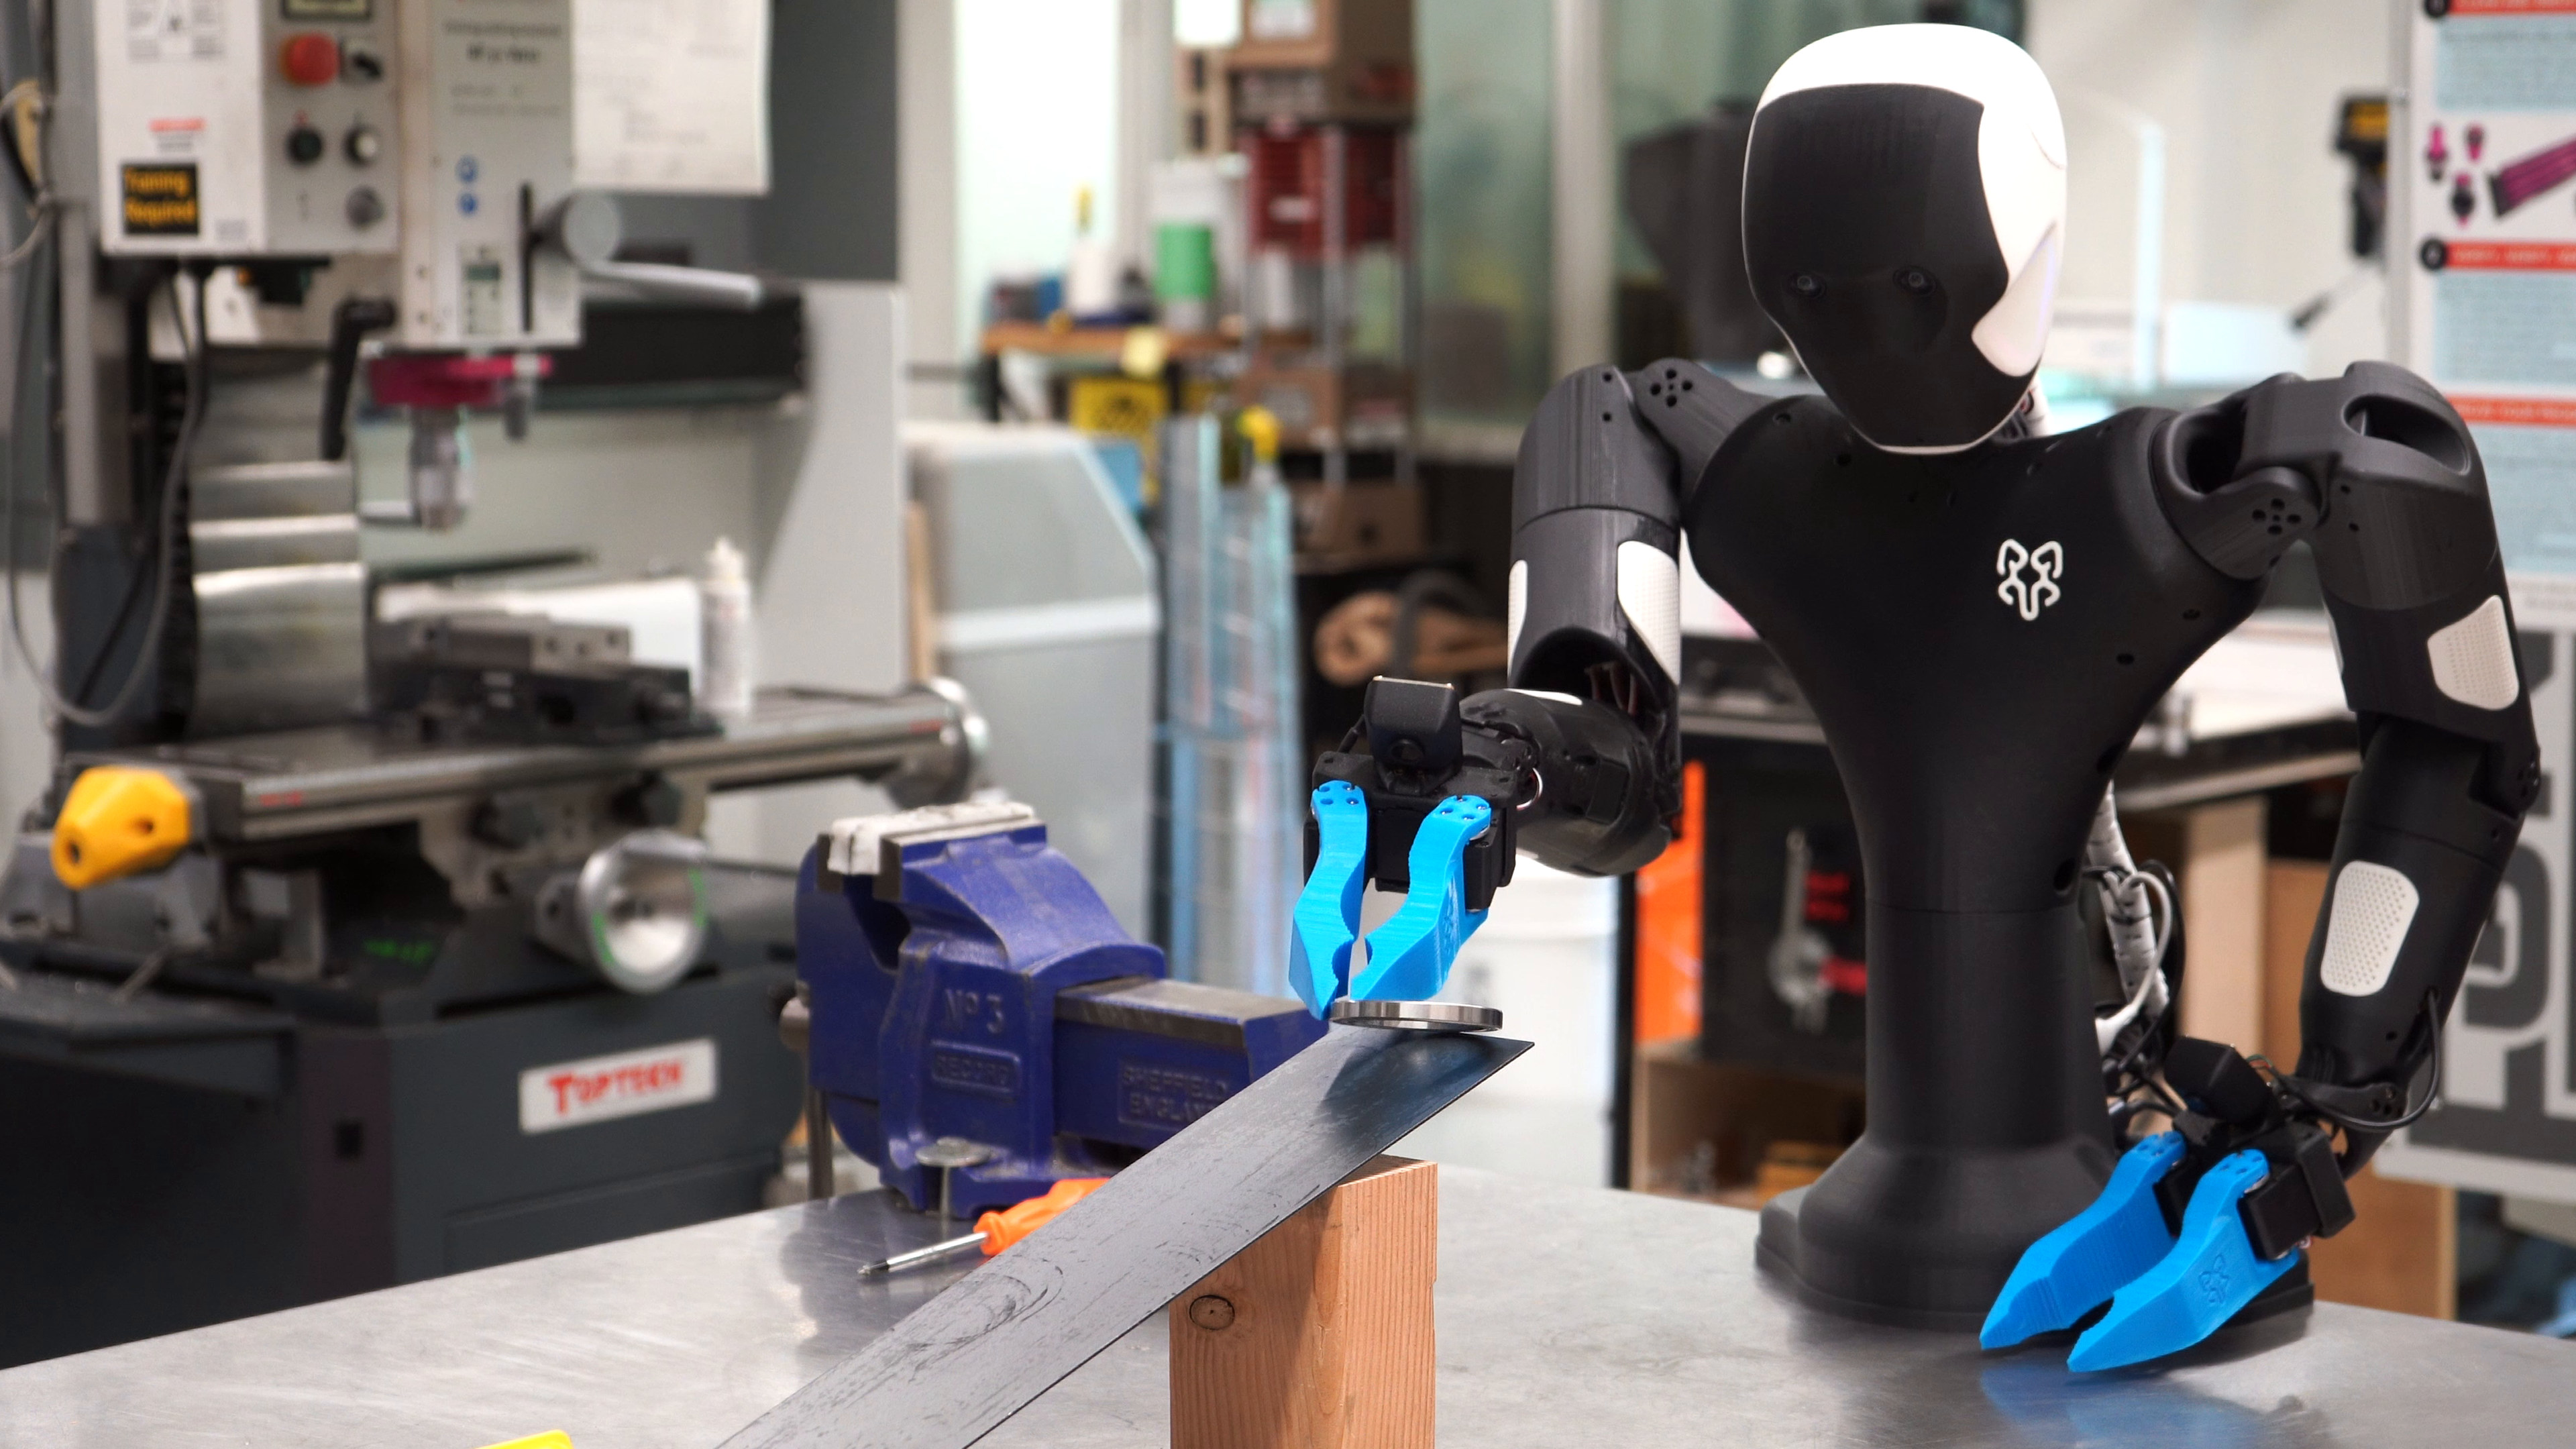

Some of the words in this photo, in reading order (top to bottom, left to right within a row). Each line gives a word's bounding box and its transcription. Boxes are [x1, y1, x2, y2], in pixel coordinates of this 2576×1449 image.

[125, 196, 196, 227] Required
[985, 993, 1005, 1034] 3
[1123, 1067, 1228, 1099] SHEFFIELD
